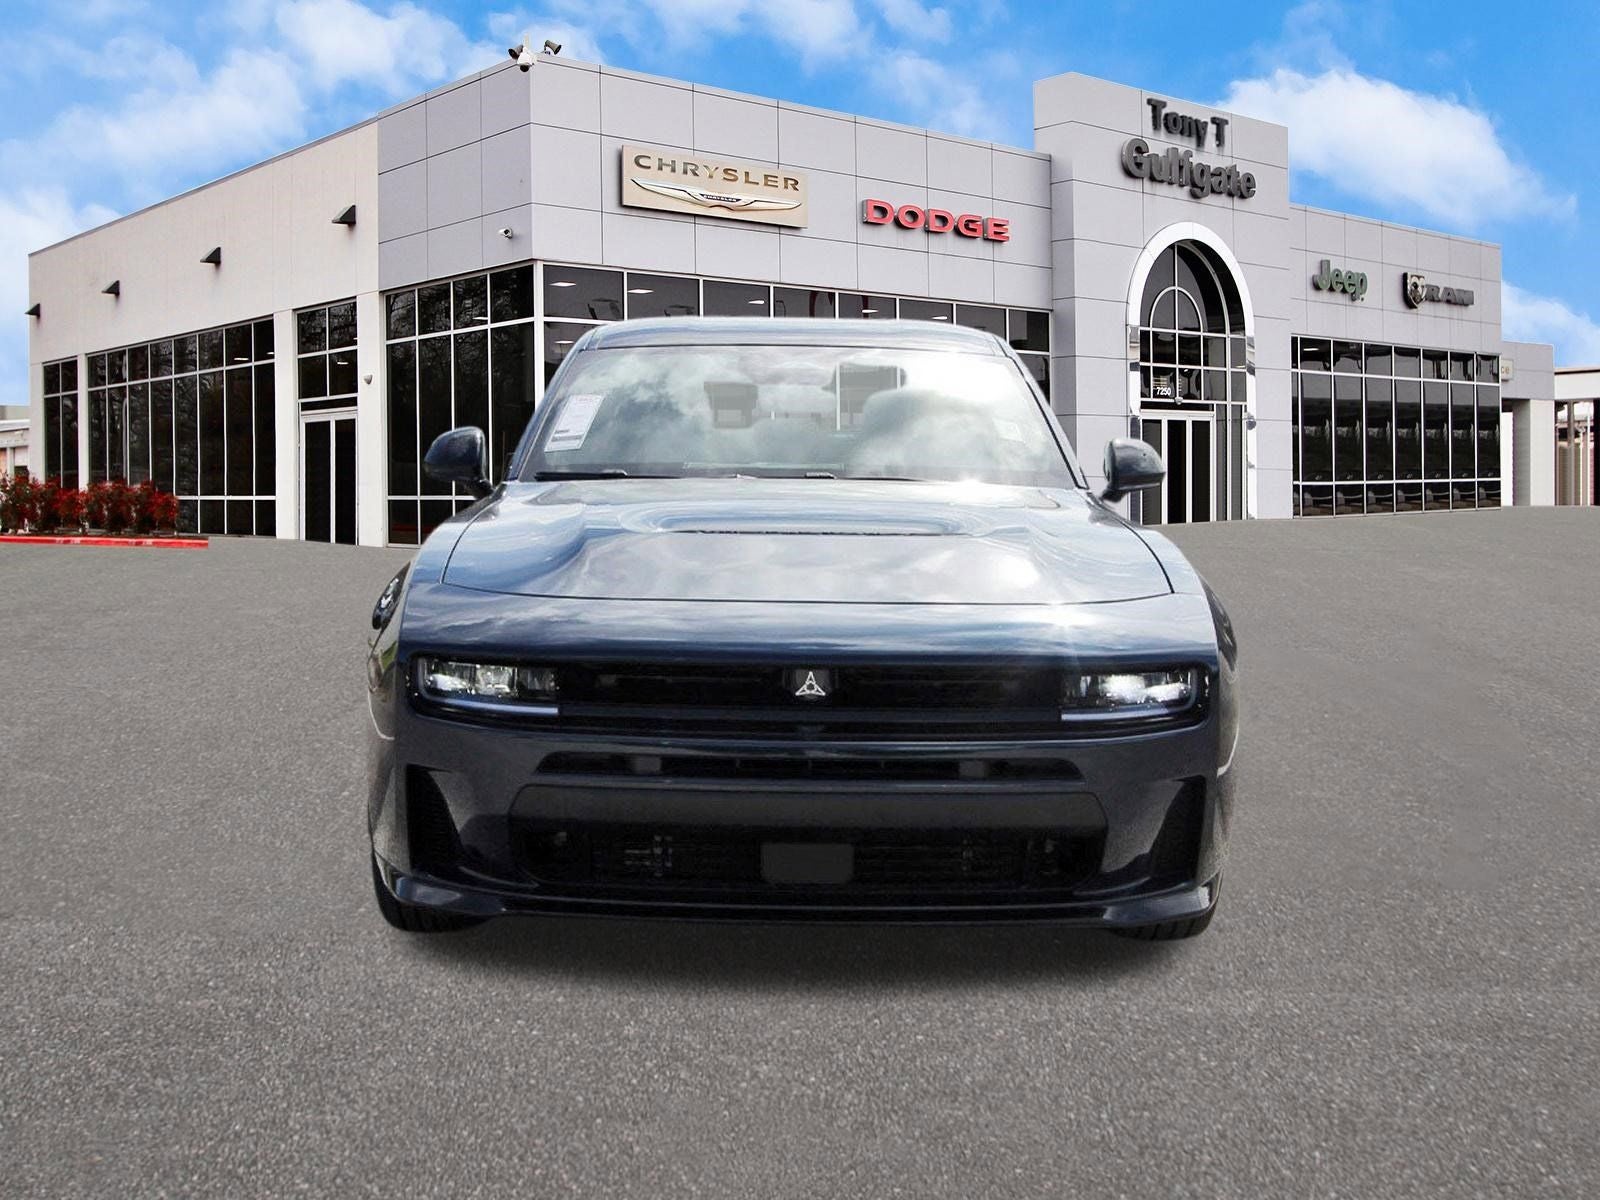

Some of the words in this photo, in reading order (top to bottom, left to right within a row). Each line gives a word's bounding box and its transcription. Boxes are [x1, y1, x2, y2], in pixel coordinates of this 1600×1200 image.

[1147, 98, 1208, 148] Tony
[1210, 116, 1229, 147] T
[633, 154, 800, 192] CHRYSLER
[1121, 138, 1256, 199] Gulfgate
[863, 199, 1010, 242] DODGE
[1312, 259, 1367, 301] Jeep
[1424, 283, 1474, 306] RAM
[1156, 386, 1172, 396] 7250
